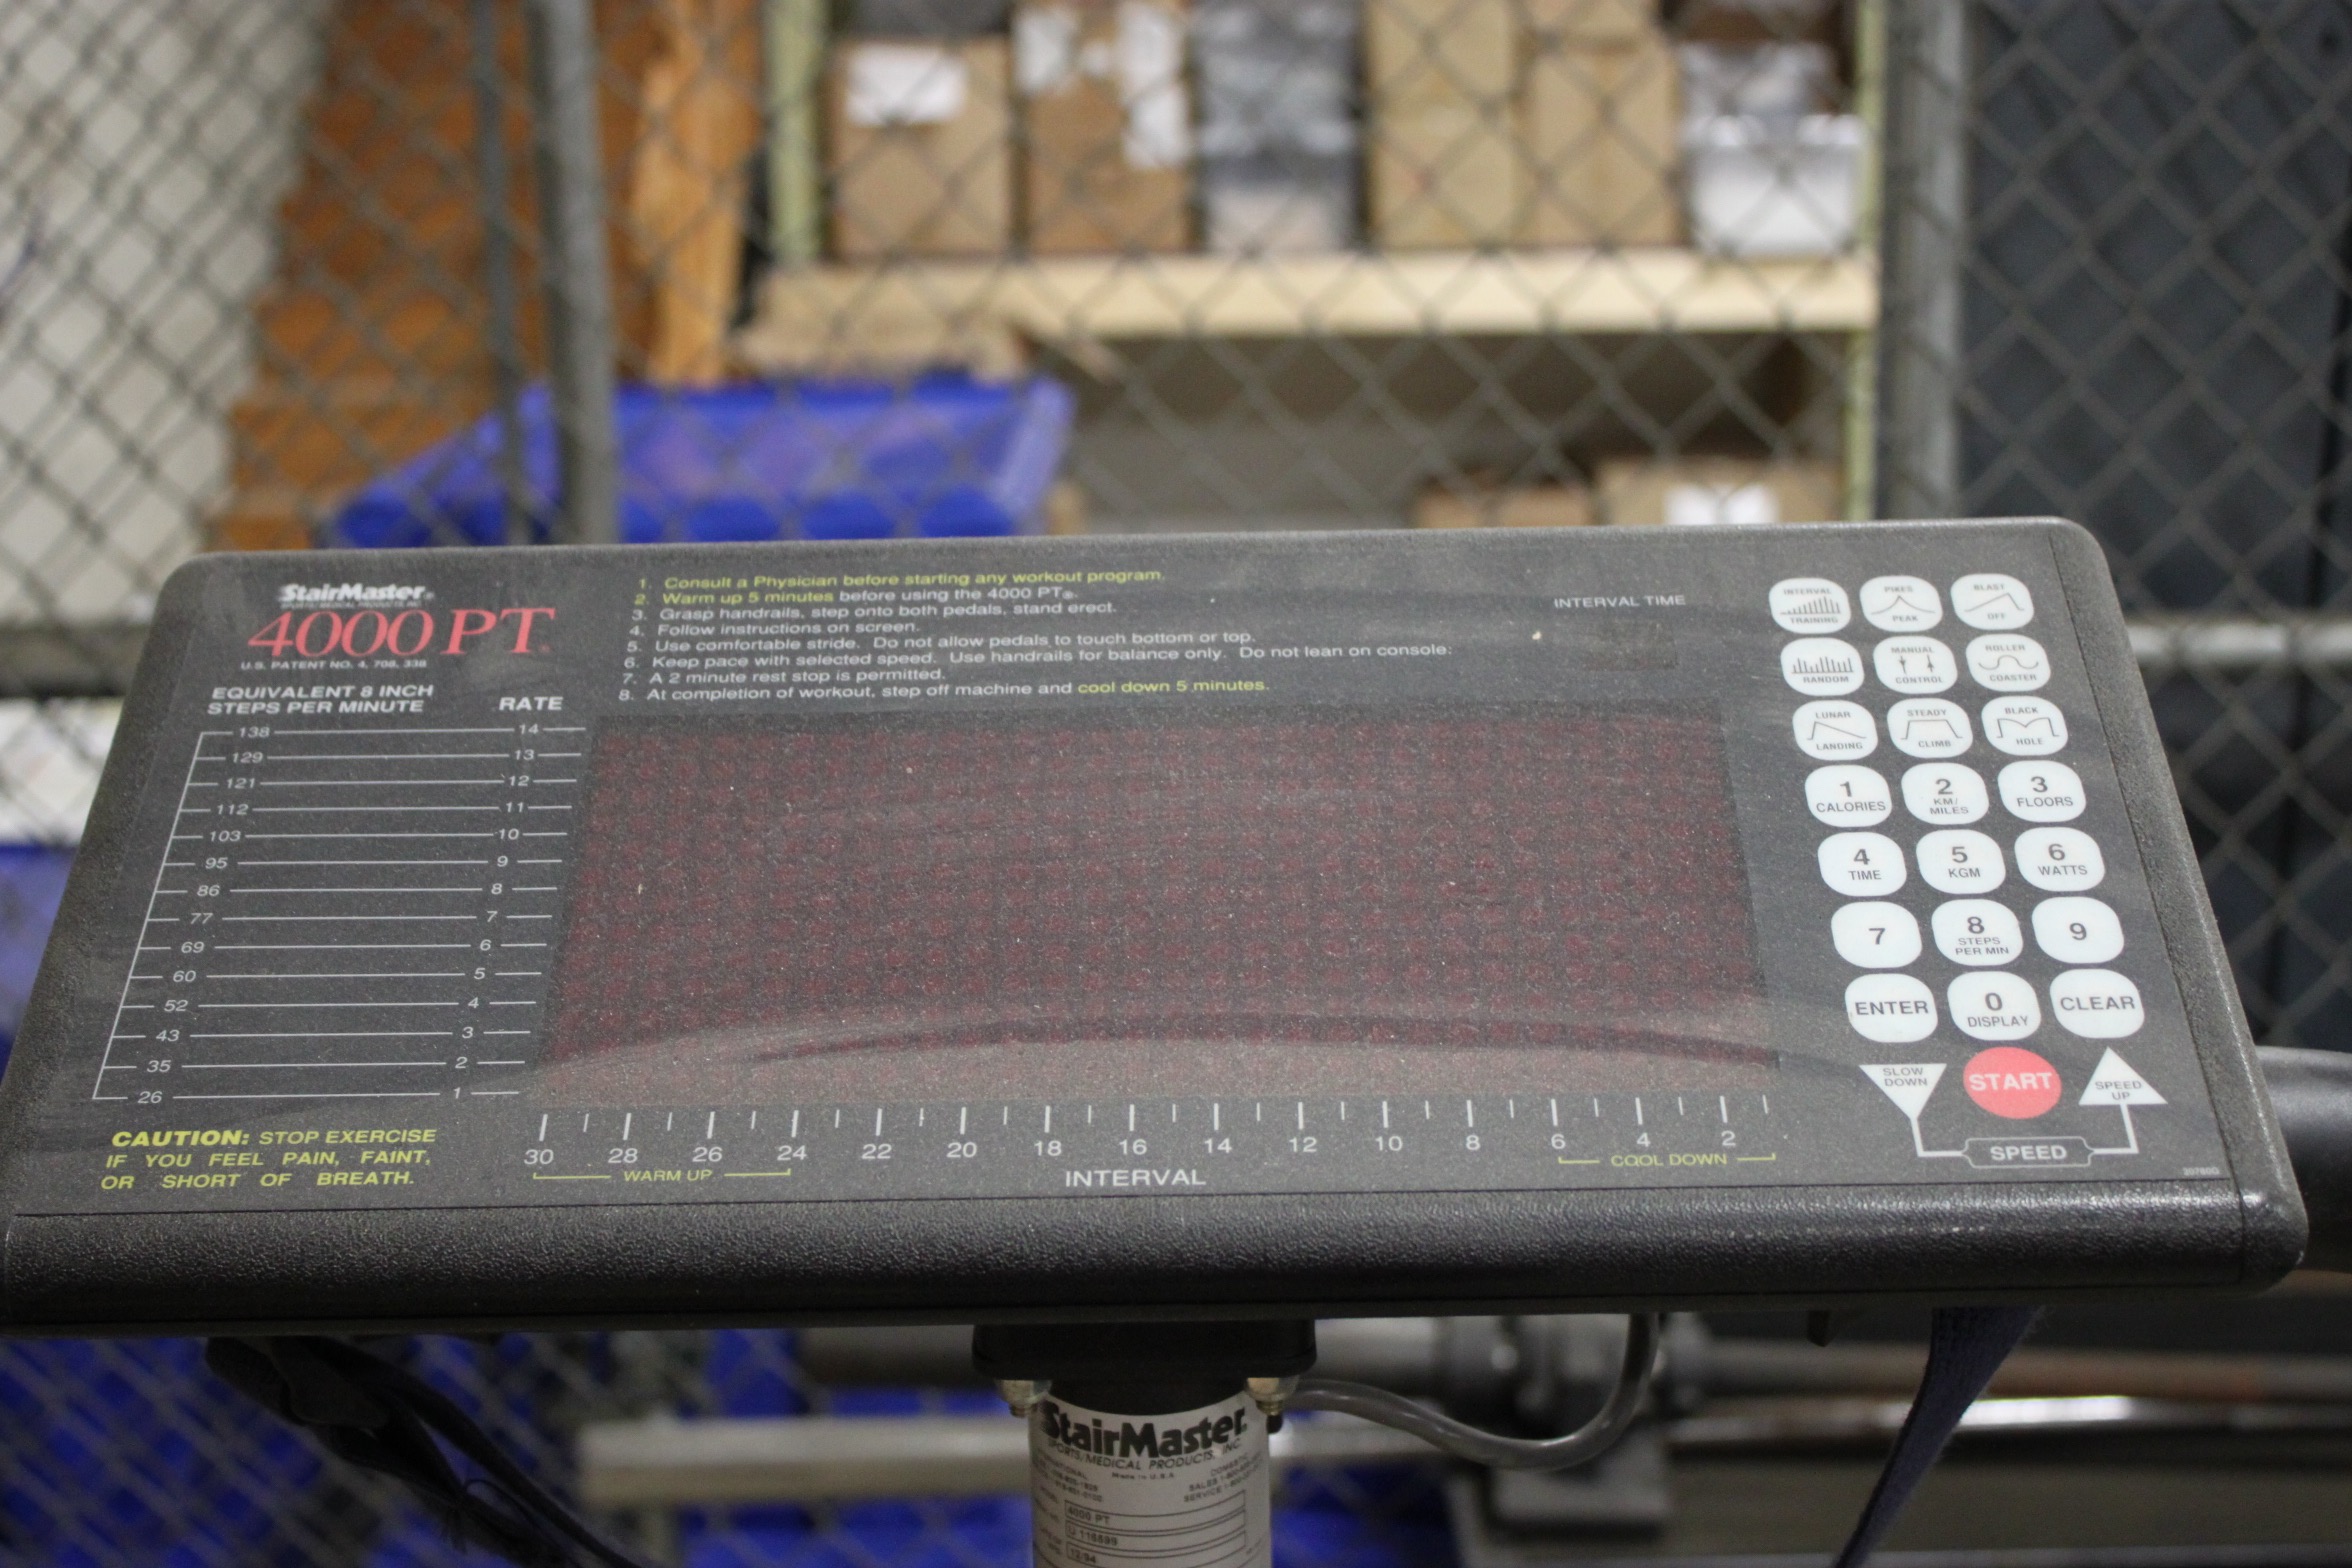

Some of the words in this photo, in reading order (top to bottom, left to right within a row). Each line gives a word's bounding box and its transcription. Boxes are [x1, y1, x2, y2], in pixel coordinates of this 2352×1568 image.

[665, 575, 732, 589] Consult
[737, 578, 748, 587] a
[754, 573, 838, 591] Physician
[844, 572, 900, 586] before
[905, 571, 970, 589] starting
[976, 573, 1007, 587] any
[1013, 569, 1082, 583] workout
[1088, 571, 1165, 585] program.
[1554, 597, 1640, 608] INTERVAL
[1643, 595, 1686, 606] TIME
[247, 610, 435, 657] 4000
[630, 624, 644, 636] 4.
[658, 622, 715, 636] Follow
[722, 620, 821, 635] instructions
[828, 623, 849, 633] on
[856, 622, 920, 632] screen.
[627, 640, 643, 652] 5.
[656, 639, 690, 652] Use
[697, 637, 801, 651] comfortable
[808, 636, 861, 649] stride.
[874, 635, 898, 648] Do
[905, 636, 932, 648] not
[939, 634, 984, 647] allow
[990, 633, 1048, 650] pedals
[1055, 633, 1071, 645] to
[1078, 631, 1126, 645] touch
[1133, 630, 1194, 644] bottom
[1200, 633, 1218, 643] or
[1223, 630, 1255, 646] top.
[1985, 644, 2025, 652] ROLLER
[1895, 676, 1943, 684] CONTROL
[212, 686, 355, 699] EQUIVALENT
[360, 686, 373, 698] 8
[378, 685, 434, 697] INCH
[619, 689, 634, 701] 8.
[647, 688, 667, 701] At
[672, 686, 771, 705] completion
[777, 686, 794, 699] of
[800, 685, 875, 700] workout,
[883, 685, 921, 701] step
[927, 683, 950, 696] off
[956, 682, 1033, 696] machine
[1039, 681, 1073, 694] and
[1078, 680, 1116, 694] cool
[1121, 680, 1170, 693] down
[1177, 679, 1188, 692] 5
[1193, 678, 1269, 692] minutes.
[207, 701, 279, 715] STEPS
[287, 701, 333, 714] PER
[338, 700, 424, 713] MINUTE
[499, 697, 563, 711] RATE
[1815, 711, 1851, 719] LUNAR
[1907, 709, 1947, 717] STEADY
[239, 727, 270, 739] 138
[1918, 740, 1951, 748] CLIMB
[2016, 737, 2043, 745] HOLE
[232, 752, 263, 764] 129
[226, 778, 256, 789] 121
[1840, 781, 1853, 797] 1
[1935, 778, 1953, 795] 2
[2031, 776, 2048, 793] 3
[216, 804, 249, 815] 112
[1816, 801, 1886, 812] CALORIES
[2017, 797, 2073, 807] FLOORS
[209, 830, 241, 842] 103
[1853, 848, 1870, 865] 4
[1952, 846, 1968, 863] 5
[2048, 844, 2065, 861] 6
[205, 857, 228, 869] 95
[2038, 865, 2088, 876] WATTS
[1848, 870, 1882, 880] TIME
[1948, 868, 1981, 878] KGM
[197, 884, 220, 897] 86
[190, 913, 213, 924] 77
[1967, 916, 1984, 934] 8
[1868, 927, 1885, 945] 7
[2069, 922, 2087, 940] 9
[181, 941, 204, 954] 69
[1958, 937, 2000, 945] STEPS
[1955, 947, 1981, 955] PER
[1985, 947, 2009, 955] MIN
[173, 970, 196, 983] 60
[164, 1000, 188, 1012] 52
[1855, 1001, 1929, 1016] ENTER
[1985, 992, 2003, 1011] 0
[2060, 996, 2136, 1011] CLEAR
[1967, 1016, 2029, 1028] DISPLAY
[156, 1029, 180, 1042] 43
[146, 1060, 171, 1072] 35
[1882, 1067, 1924, 1076] SLOW
[1884, 1078, 1928, 1087] DOWN
[1969, 1072, 2052, 1091] START
[2095, 1081, 2142, 1090] SPEED
[137, 1091, 162, 1104] 26
[2111, 1091, 2130, 1100] UP
[111, 1130, 249, 1147] CAUTION:
[259, 1132, 319, 1144] STOP
[325, 1130, 437, 1143] EXERCISE
[1205, 1138, 1232, 1153] 14
[1289, 1137, 1317, 1152] 12
[1375, 1136, 1403, 1151] 10
[1466, 1135, 1480, 1150] 8
[1551, 1134, 1566, 1149] 6
[1636, 1132, 1650, 1147] 4
[1721, 1131, 1736, 1146] 2
[692, 1147, 723, 1162] 26
[777, 1145, 807, 1161] 24
[861, 1144, 892, 1159] 22
[947, 1142, 977, 1158] 20
[1034, 1141, 1062, 1156] 18
[1119, 1140, 1147, 1155] 16
[1990, 1146, 2068, 1161] SPEED
[106, 1155, 127, 1168] IF
[146, 1154, 192, 1167] YOU
[209, 1153, 264, 1166] FEEL
[282, 1152, 339, 1166] PAIN,
[360, 1151, 431, 1166] FAINT,
[524, 1150, 554, 1165] 30
[608, 1148, 638, 1164] 28
[1611, 1155, 1664, 1167] COOL
[1669, 1154, 1727, 1166] DOWN
[101, 1176, 134, 1190] OR
[162, 1174, 241, 1188] SHORT
[260, 1174, 292, 1187] OF
[317, 1172, 414, 1186] BREATH.
[624, 1170, 681, 1181] WARM
[686, 1169, 712, 1181] UP
[1065, 1170, 1206, 1186] INTERVAL
